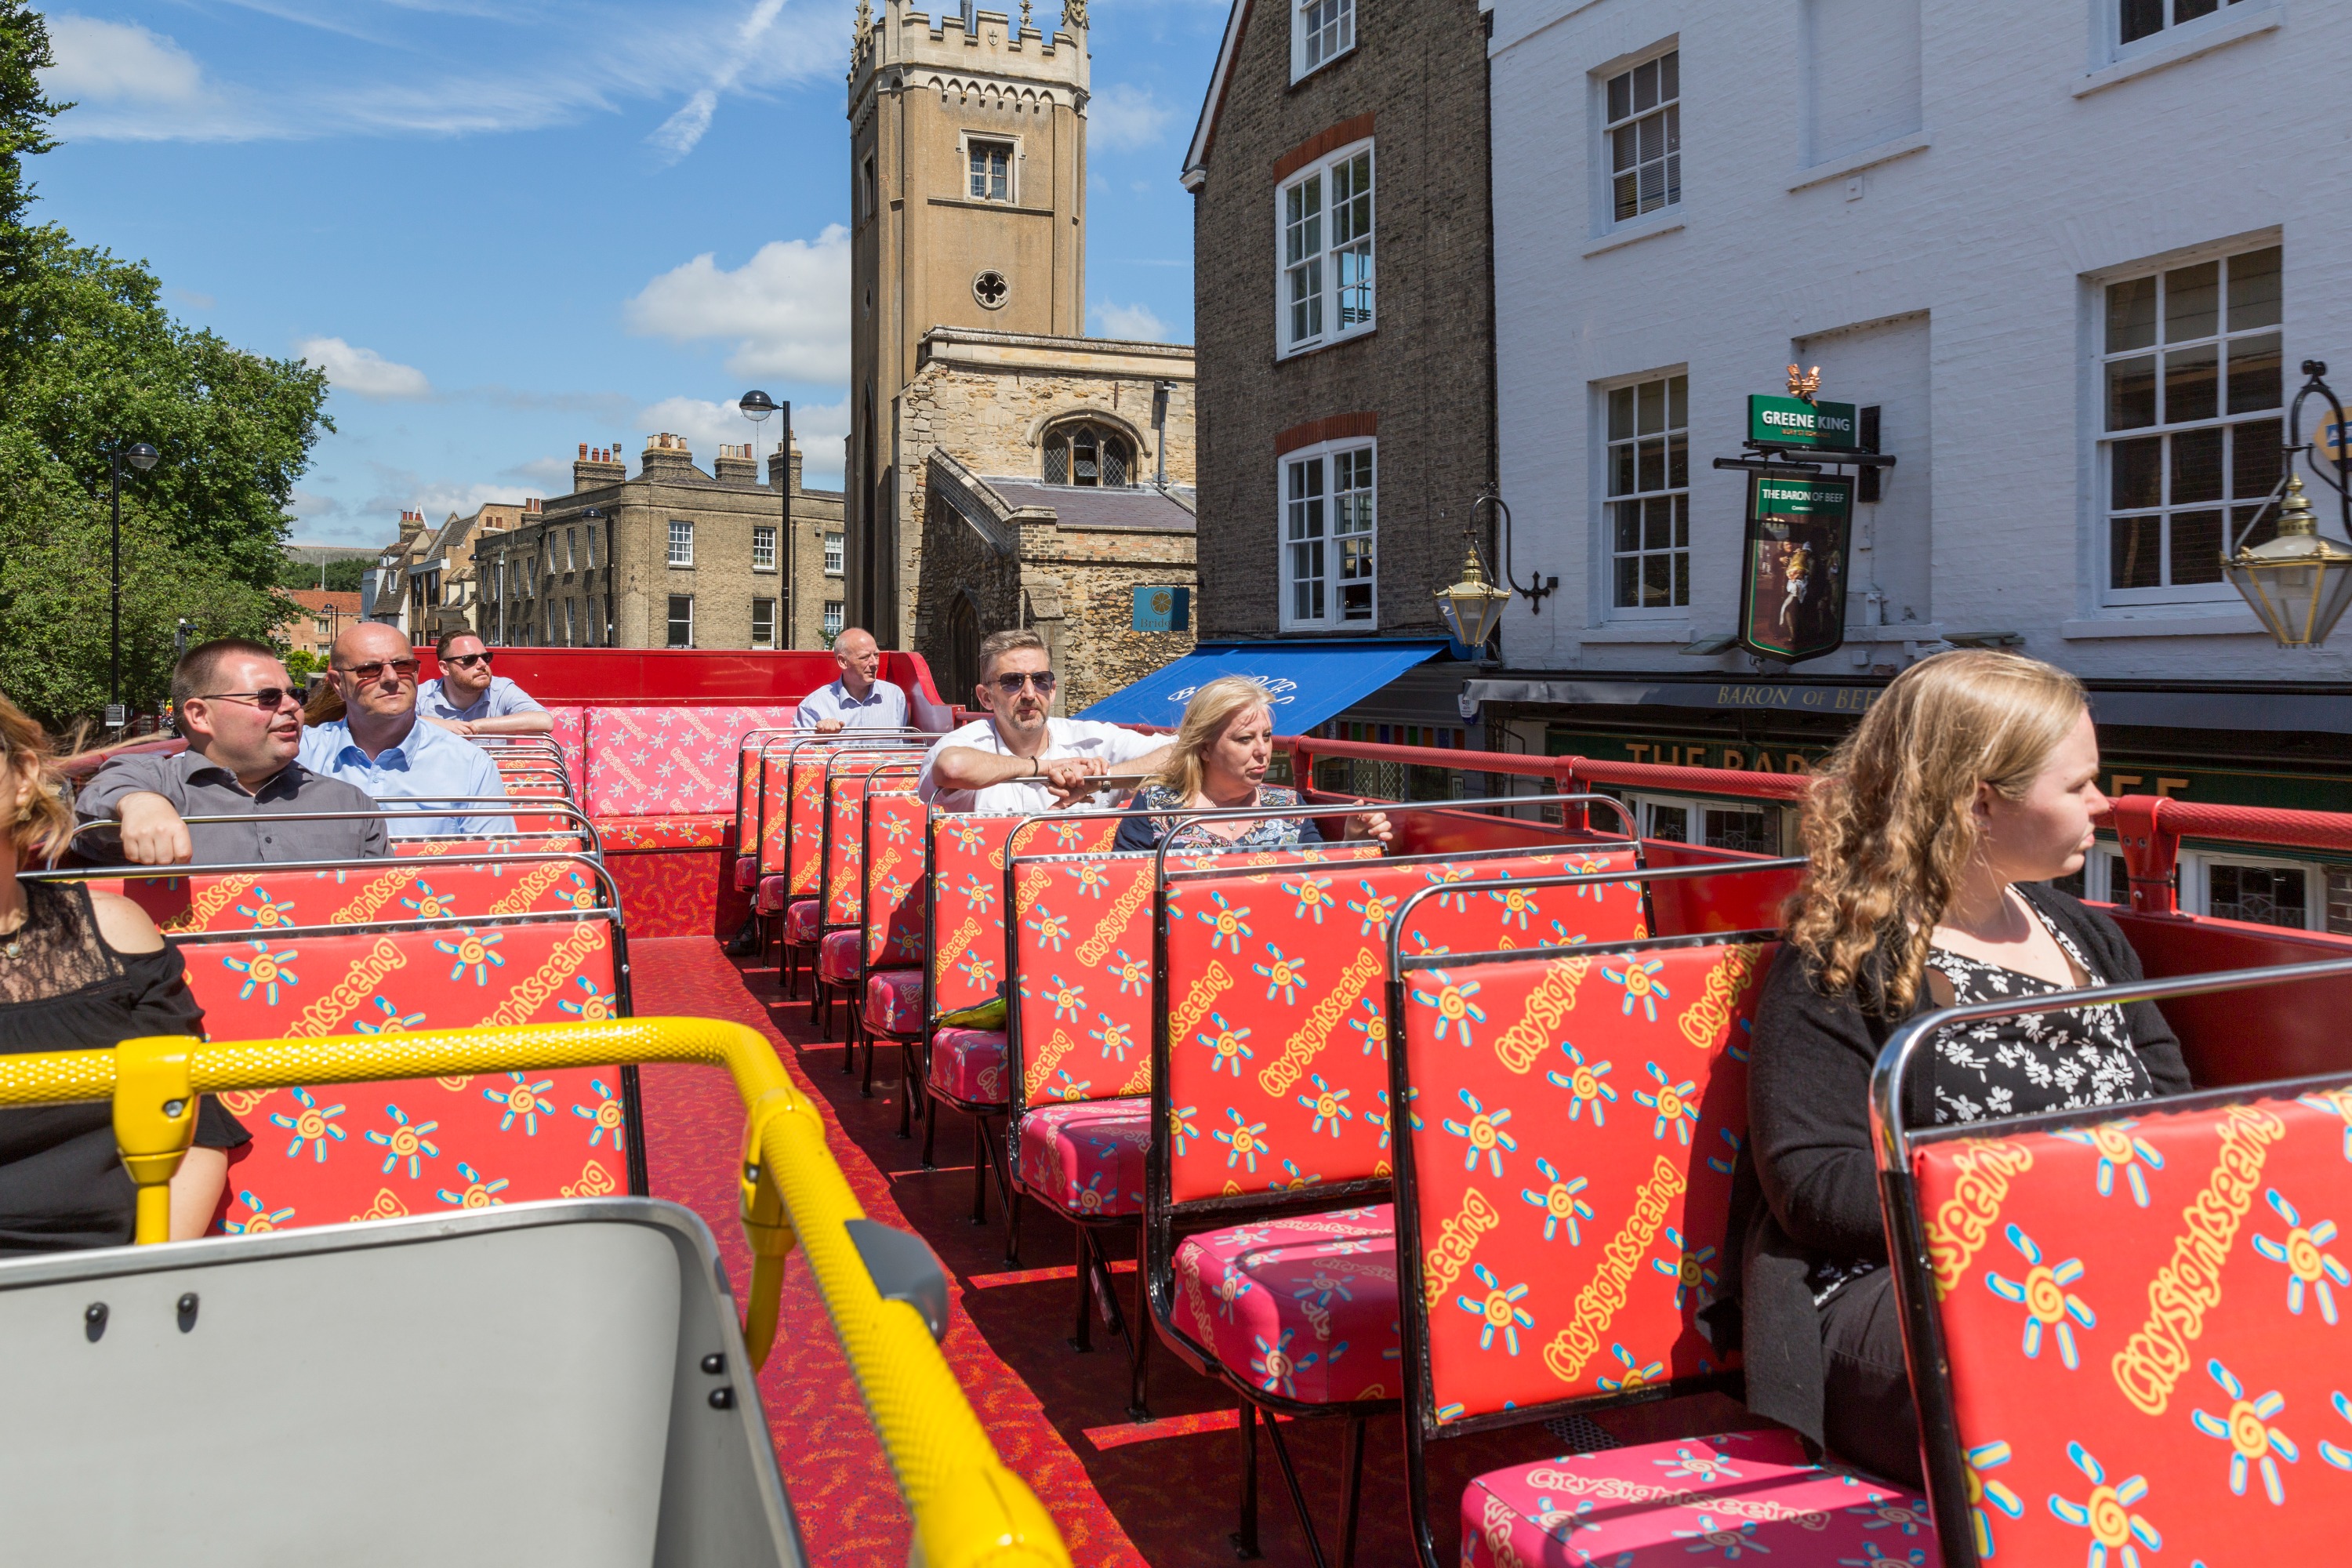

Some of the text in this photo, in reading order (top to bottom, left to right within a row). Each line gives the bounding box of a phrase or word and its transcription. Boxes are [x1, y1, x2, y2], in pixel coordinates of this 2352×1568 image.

[1762, 410, 1850, 431] GREENE KING
[1762, 489, 1844, 503] THE BARON OF BEEF
[1717, 686, 1794, 705] BARON
[1835, 689, 1878, 710] BEE
[1258, 947, 1382, 1098] CitySightseeing
[1543, 1155, 1687, 1382] CitySightseeing
[1526, 1468, 1832, 1531] CitySightseeing
